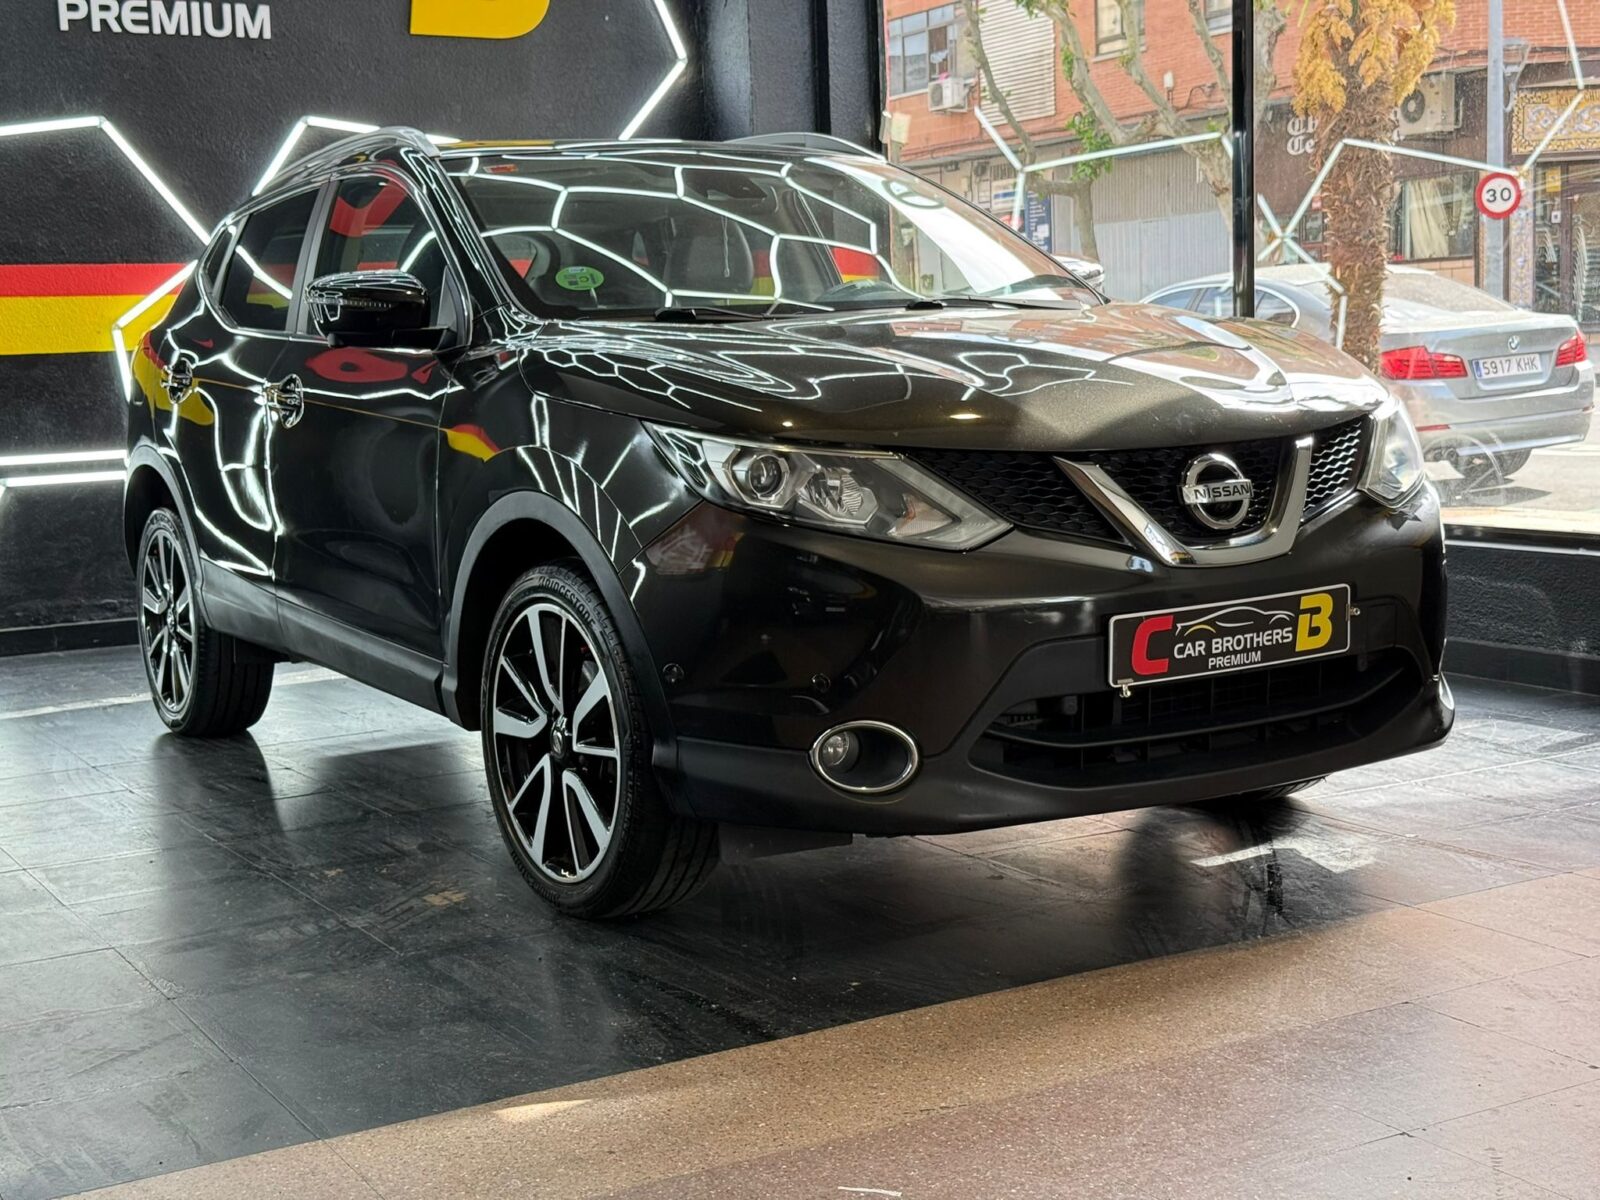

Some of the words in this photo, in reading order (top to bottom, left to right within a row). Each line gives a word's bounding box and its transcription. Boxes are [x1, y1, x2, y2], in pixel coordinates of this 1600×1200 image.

[57, 0, 272, 39] PREMIUM
[1486, 187, 1511, 203] 30
[1482, 359, 1512, 375] 5917
[1515, 356, 1539, 372] KHK
[1193, 482, 1253, 500] NISSAN
[1173, 641, 1206, 659] CAR
[1211, 627, 1293, 654] BROTHERS
[1208, 650, 1262, 670] PREMIUM
